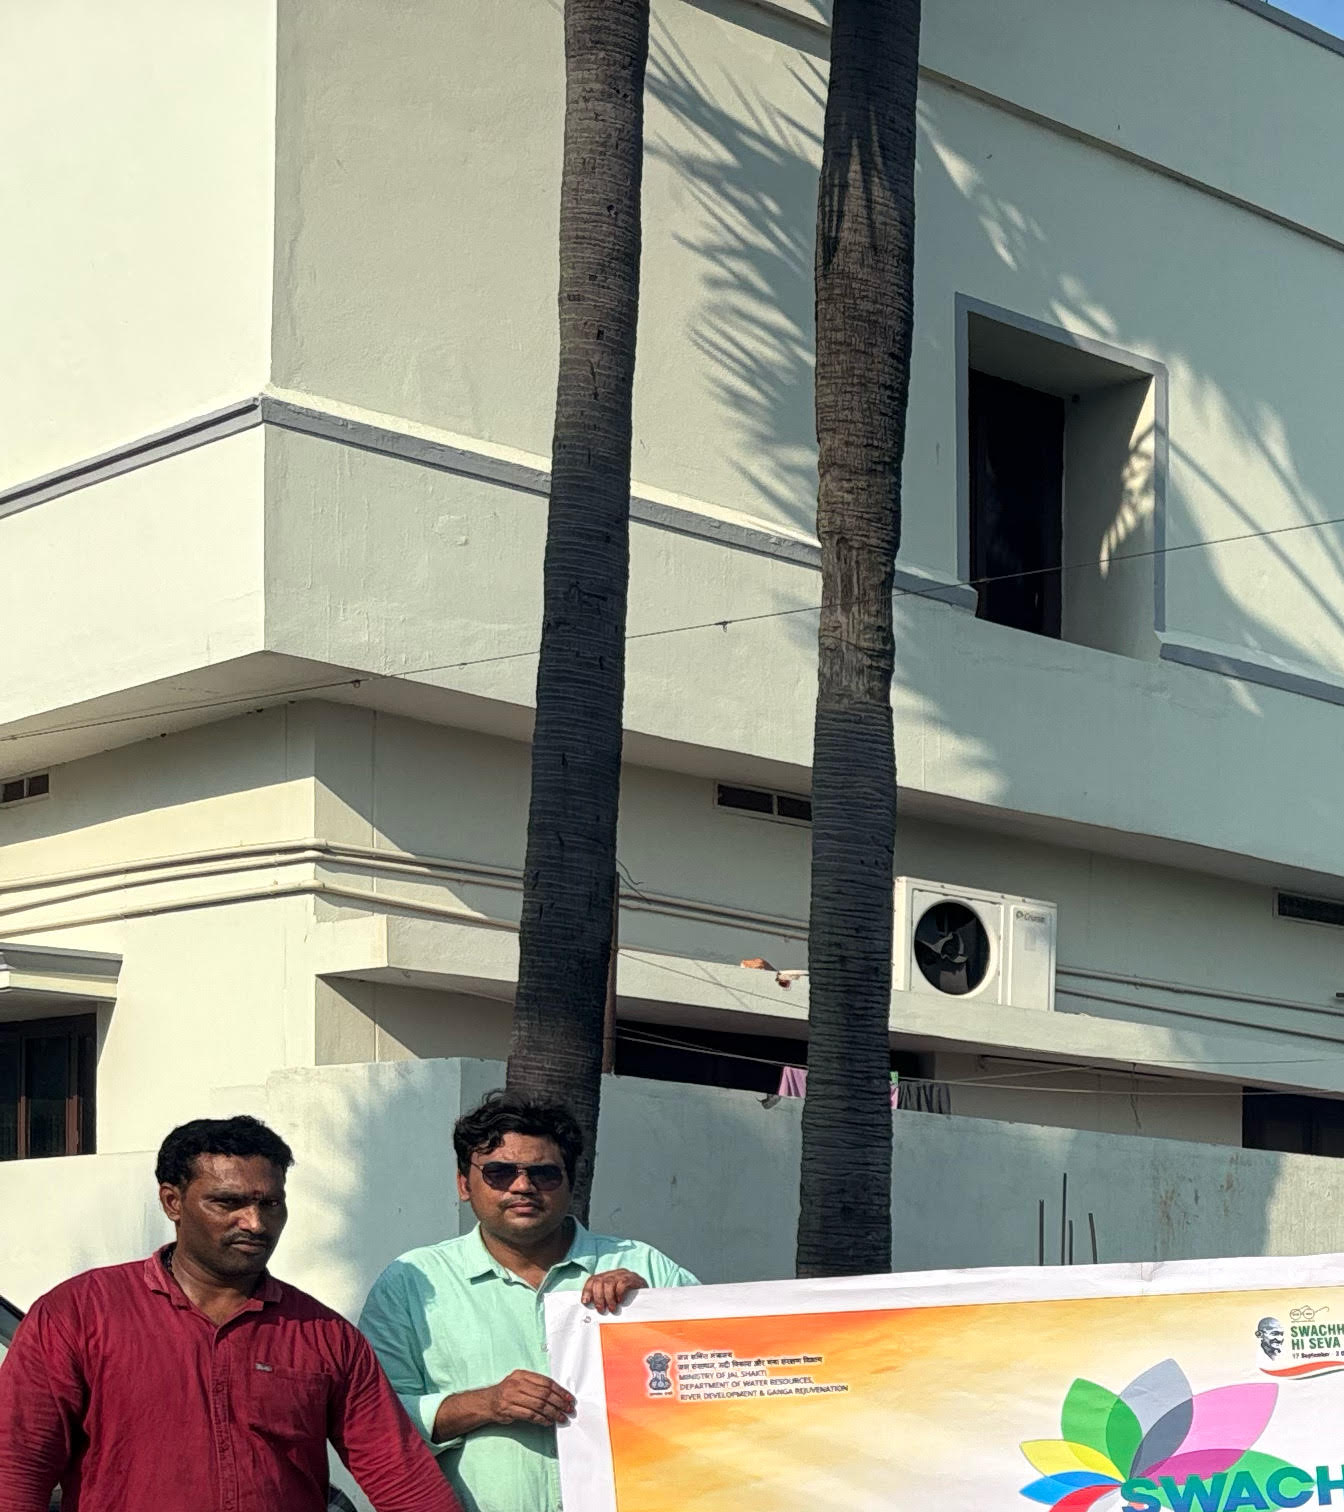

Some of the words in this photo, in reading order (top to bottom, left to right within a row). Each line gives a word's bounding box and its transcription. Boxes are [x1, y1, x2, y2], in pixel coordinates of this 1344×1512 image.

[1291, 1338, 1304, 1350] HI
[1309, 1337, 1341, 1350] SEVA
[679, 1372, 714, 1380] MINISTRY
[727, 1371, 739, 1379] JAL
[741, 1370, 767, 1378] SHAKTI
[680, 1381, 729, 1390] DEPARTMENT
[743, 1379, 768, 1387] WATER
[704, 1390, 757, 1400] DEVELOPMENT
[767, 1388, 793, 1396] GANGA
[795, 1385, 848, 1395] REJUVENATION
